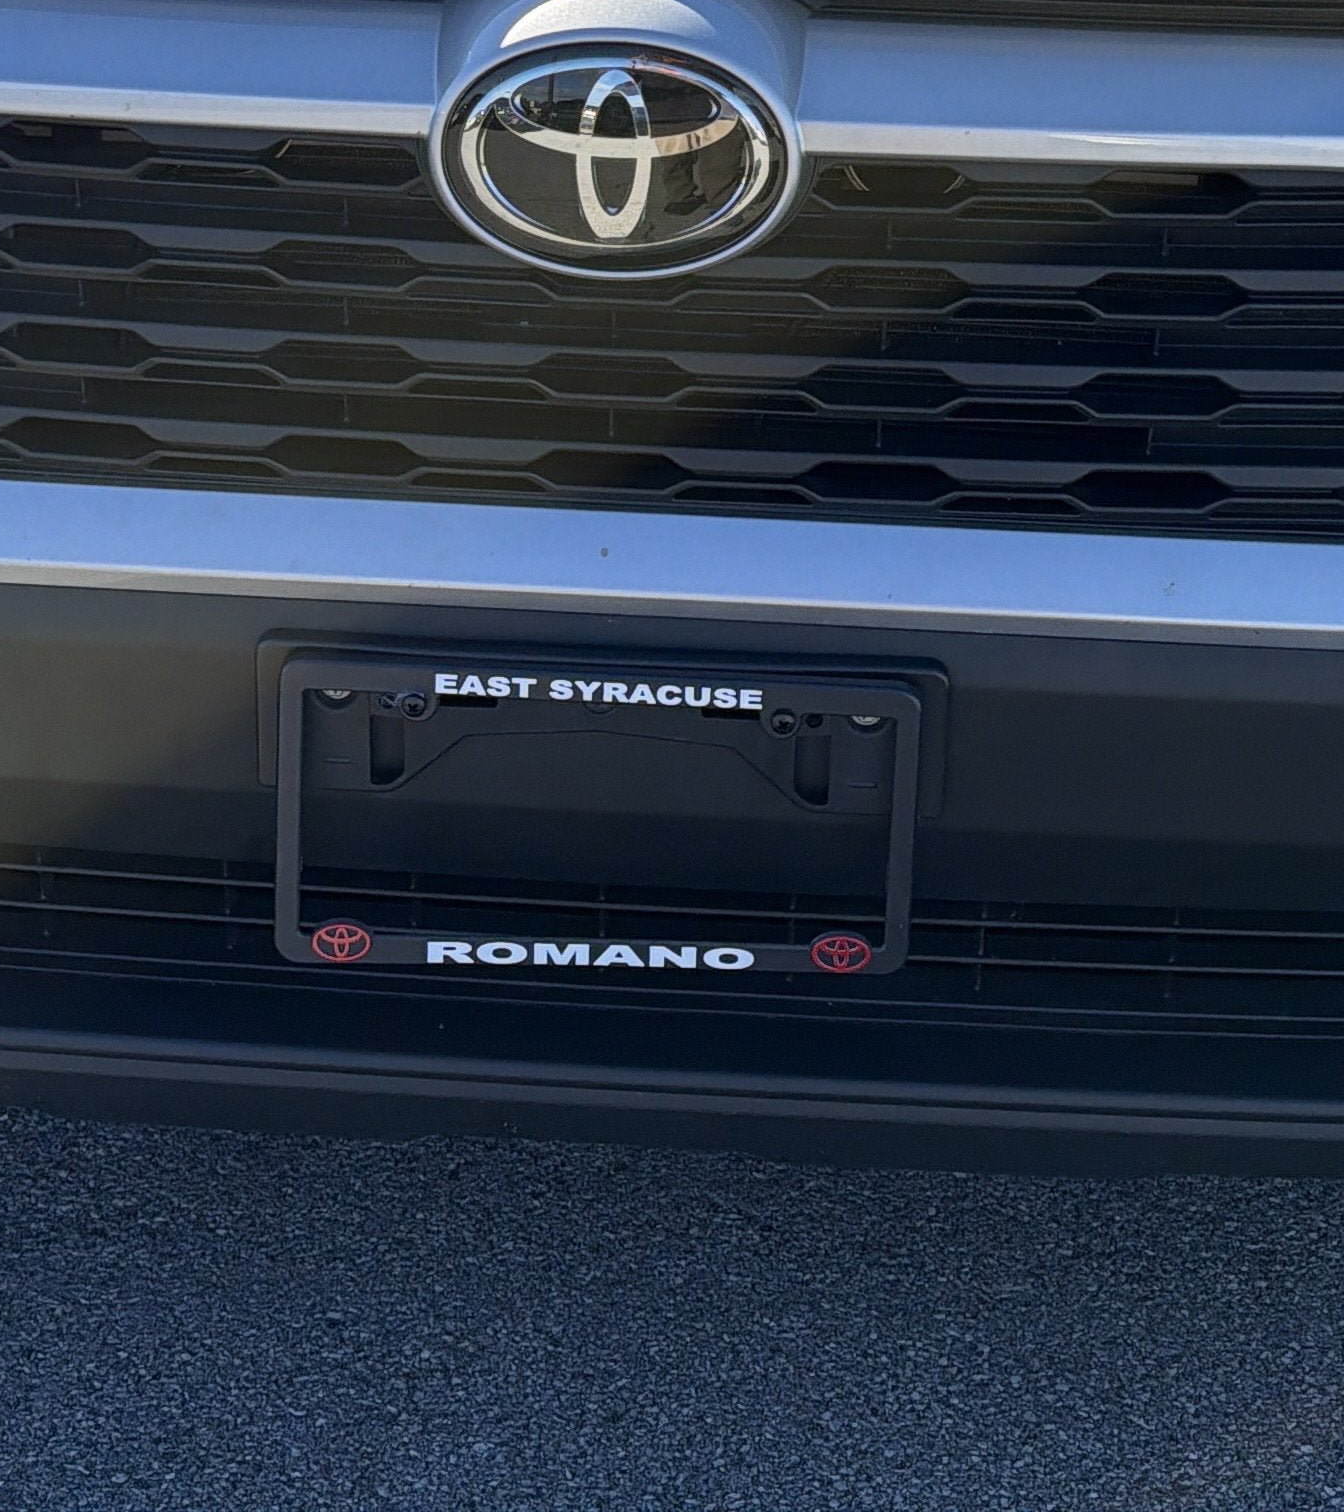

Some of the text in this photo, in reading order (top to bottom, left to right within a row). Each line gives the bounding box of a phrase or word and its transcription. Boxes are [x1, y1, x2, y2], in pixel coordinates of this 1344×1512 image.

[434, 673, 763, 711] EAST SYRACUSE
[426, 941, 755, 970] ROMANO
